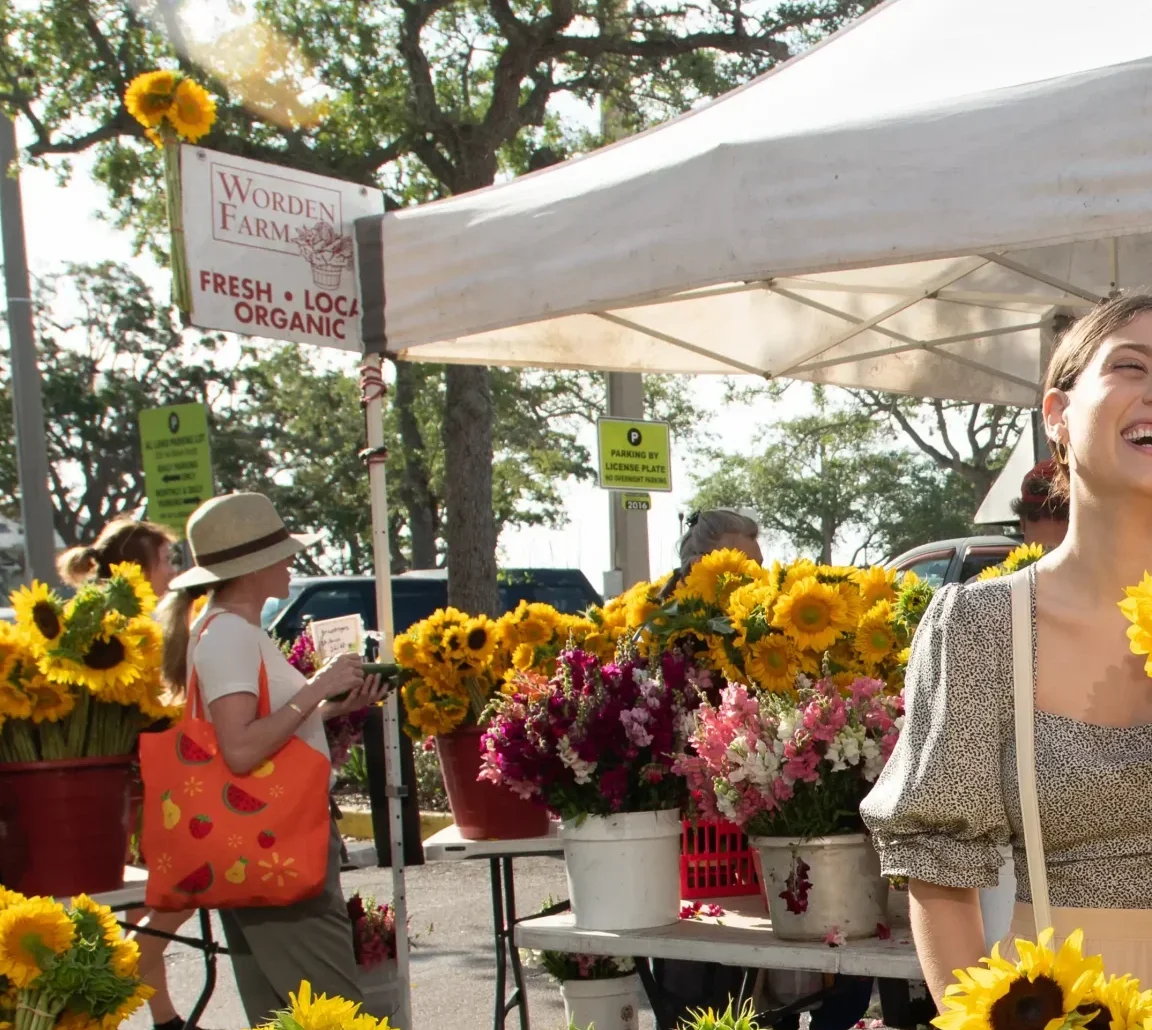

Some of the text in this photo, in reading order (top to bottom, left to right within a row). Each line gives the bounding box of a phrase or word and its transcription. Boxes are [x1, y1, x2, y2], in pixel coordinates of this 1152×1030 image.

[218, 171, 335, 222] WORDEN
[218, 201, 291, 243] FARM
[200, 270, 273, 303] FRESH
[234, 301, 346, 340] ORGANIC
[605, 462, 665, 473] LICENSE PLATE
[611, 449, 659, 460] PARKING BY
